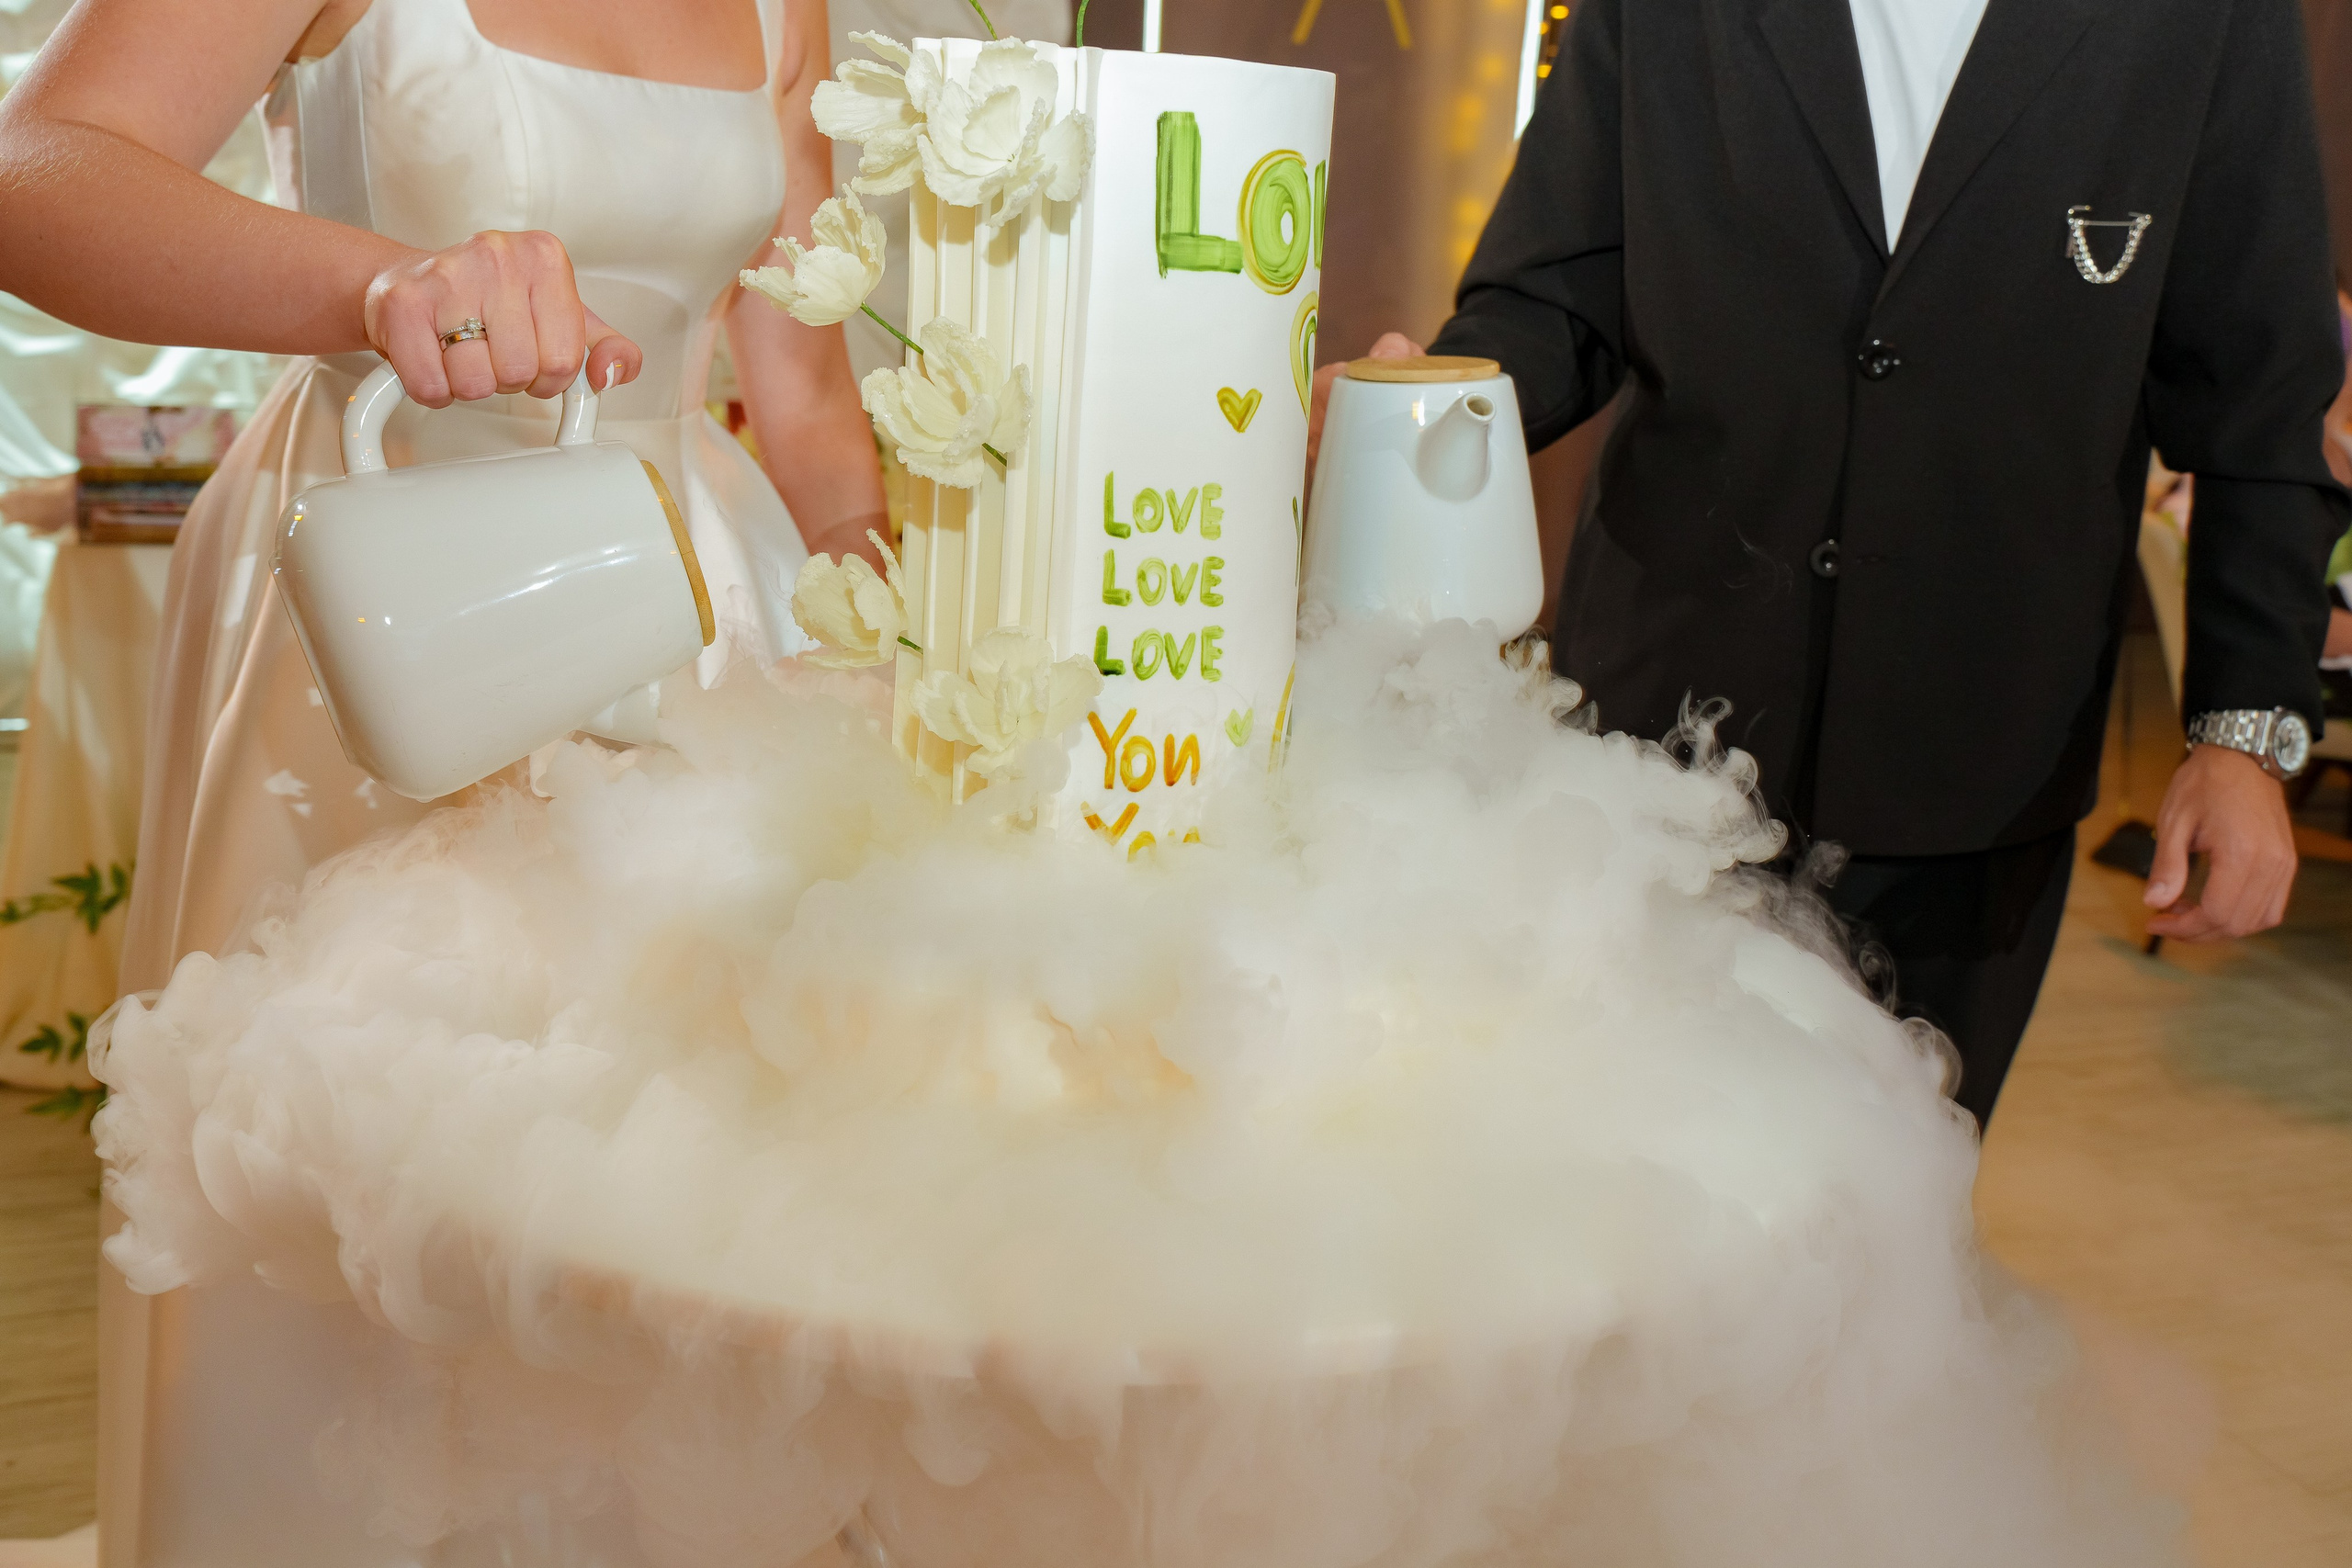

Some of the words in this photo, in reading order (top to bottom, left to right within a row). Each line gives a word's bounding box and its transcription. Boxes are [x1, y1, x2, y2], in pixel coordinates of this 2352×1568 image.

[1103, 471, 1225, 540] LOVE
[1102, 548, 1225, 607] LOVE
[1093, 625, 1225, 682] LOVE
